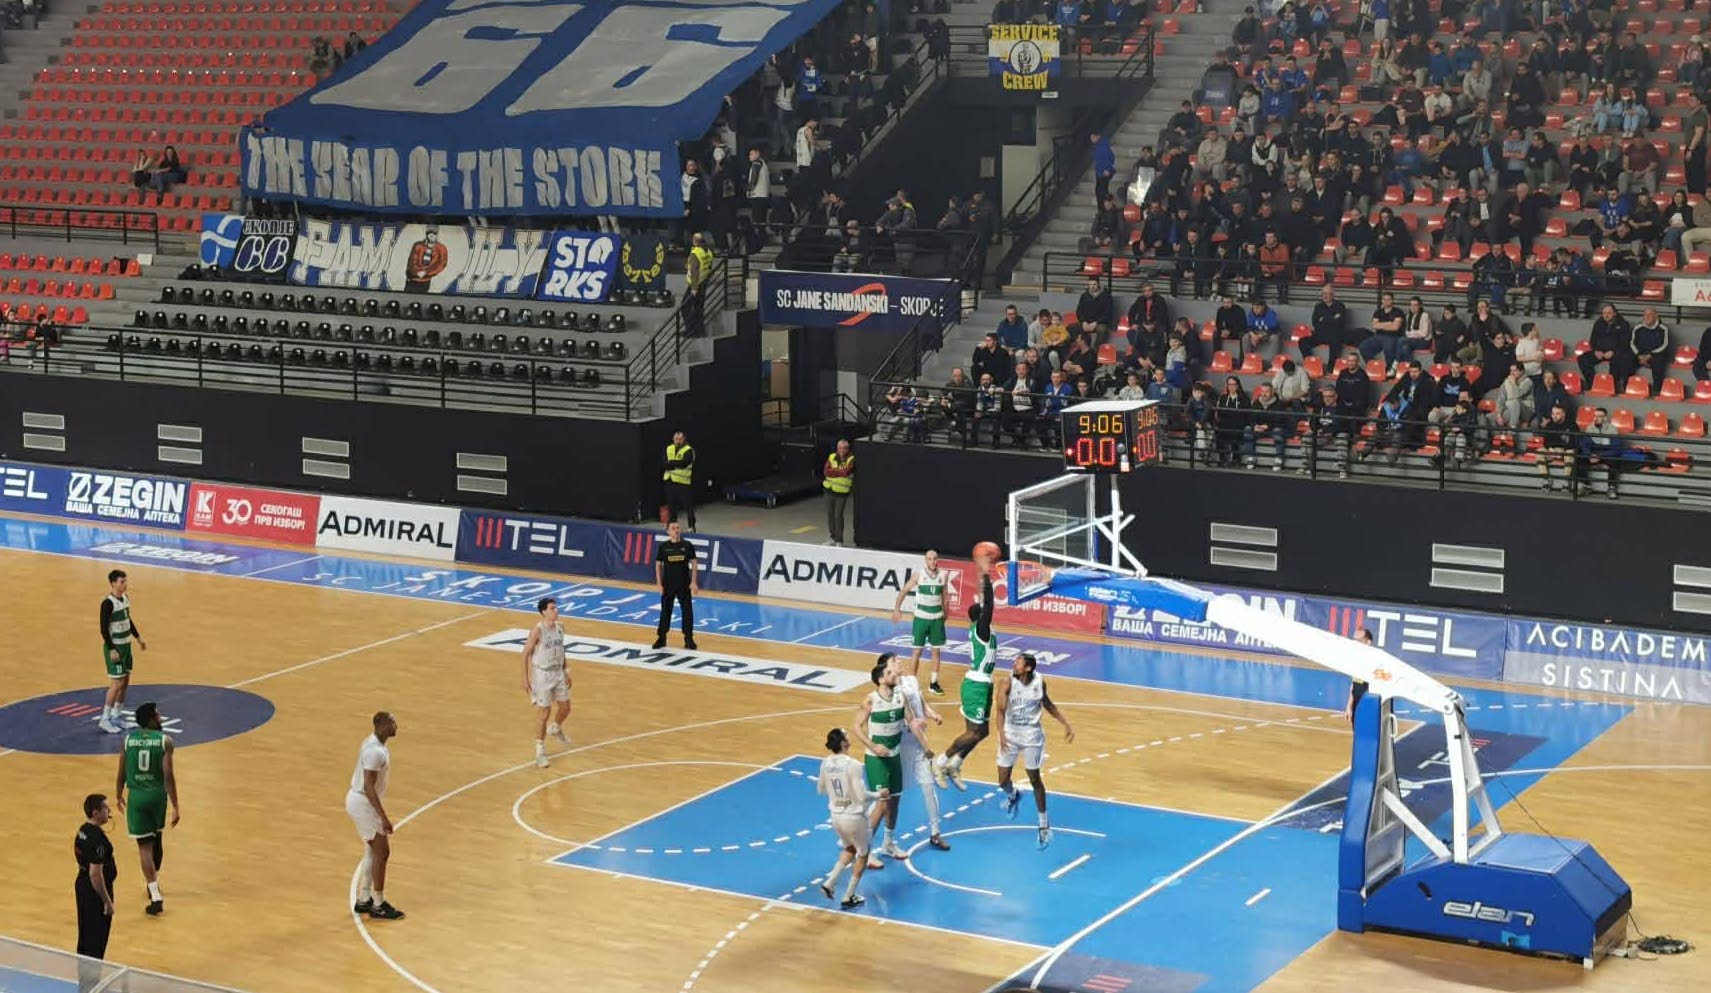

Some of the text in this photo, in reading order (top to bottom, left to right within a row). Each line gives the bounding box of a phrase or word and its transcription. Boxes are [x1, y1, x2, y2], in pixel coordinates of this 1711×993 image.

[991, 25, 1058, 41] SERVICE
[1002, 70, 1049, 90] CREW
[247, 132, 664, 210] THE YEAR OF THE STORK
[544, 270, 607, 299] RKS
[777, 289, 791, 308] SC
[793, 290, 822, 309] JANE
[823, 292, 888, 313] SANDANSKI
[1080, 415, 1123, 434] 9:06
[0, 467, 47, 499] EL
[93, 475, 185, 512] ZEGIN
[66, 501, 180, 524] ВАША СЕМЕЈНА АПТЕКА
[222, 499, 252, 525] 30
[260, 503, 303, 518] СЕКОГАШ
[318, 510, 453, 549] ADMIRAL
[302, 572, 363, 585] SC
[372, 581, 491, 600] JANE
[763, 554, 917, 597] ADMIRAL
[1112, 618, 1154, 635] ВАША
[1161, 623, 1228, 643] СЕМЕЈНА
[1526, 622, 1707, 662] ACIBADEM
[1541, 663, 1684, 700] SISTINA
[138, 749, 150, 772] 0
[1443, 901, 1535, 926] elan
